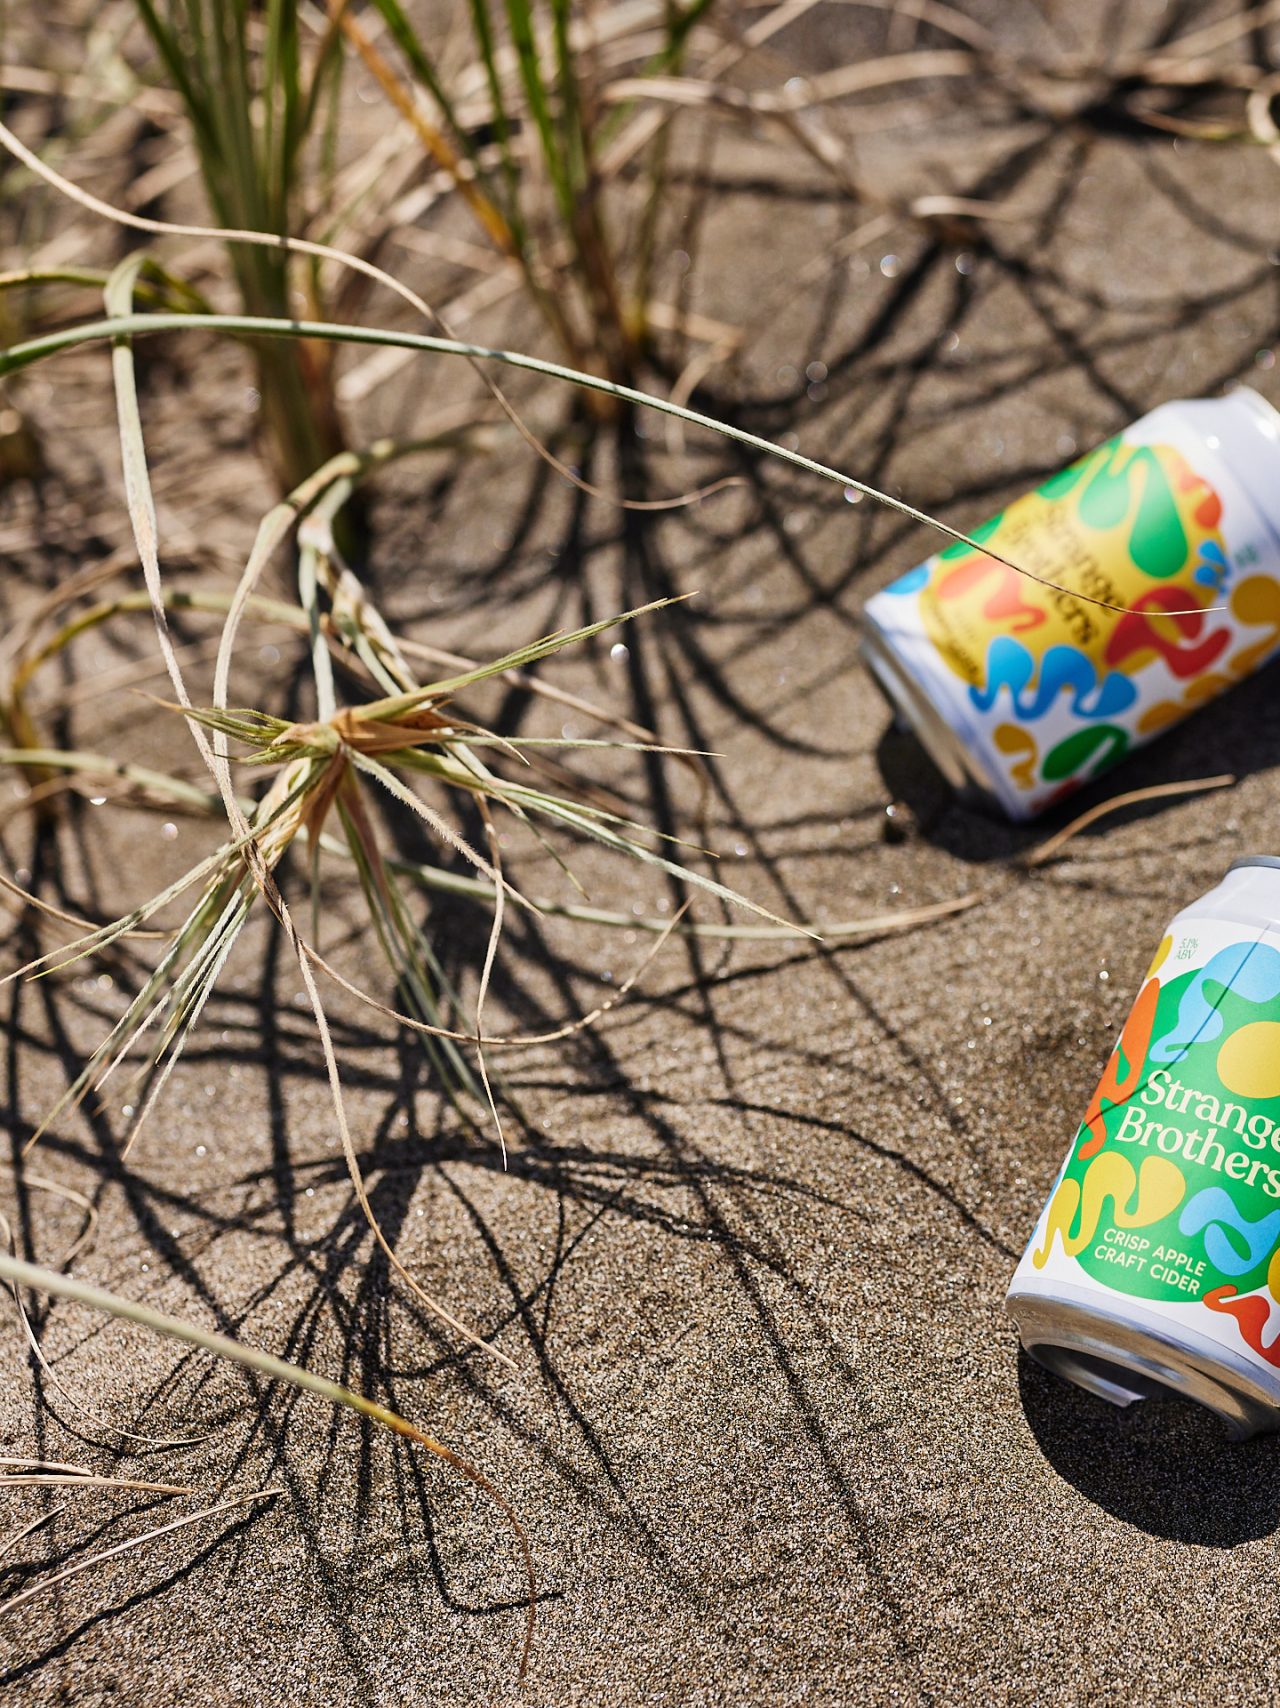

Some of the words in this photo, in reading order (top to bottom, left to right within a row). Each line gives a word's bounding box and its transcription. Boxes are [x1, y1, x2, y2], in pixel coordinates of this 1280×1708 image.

[1094, 1245, 1147, 1272] CRAFT
[1150, 1264, 1201, 1295] CIDER
[1103, 1228, 1150, 1252] CRISP
[1152, 1245, 1206, 1277] APPLE
